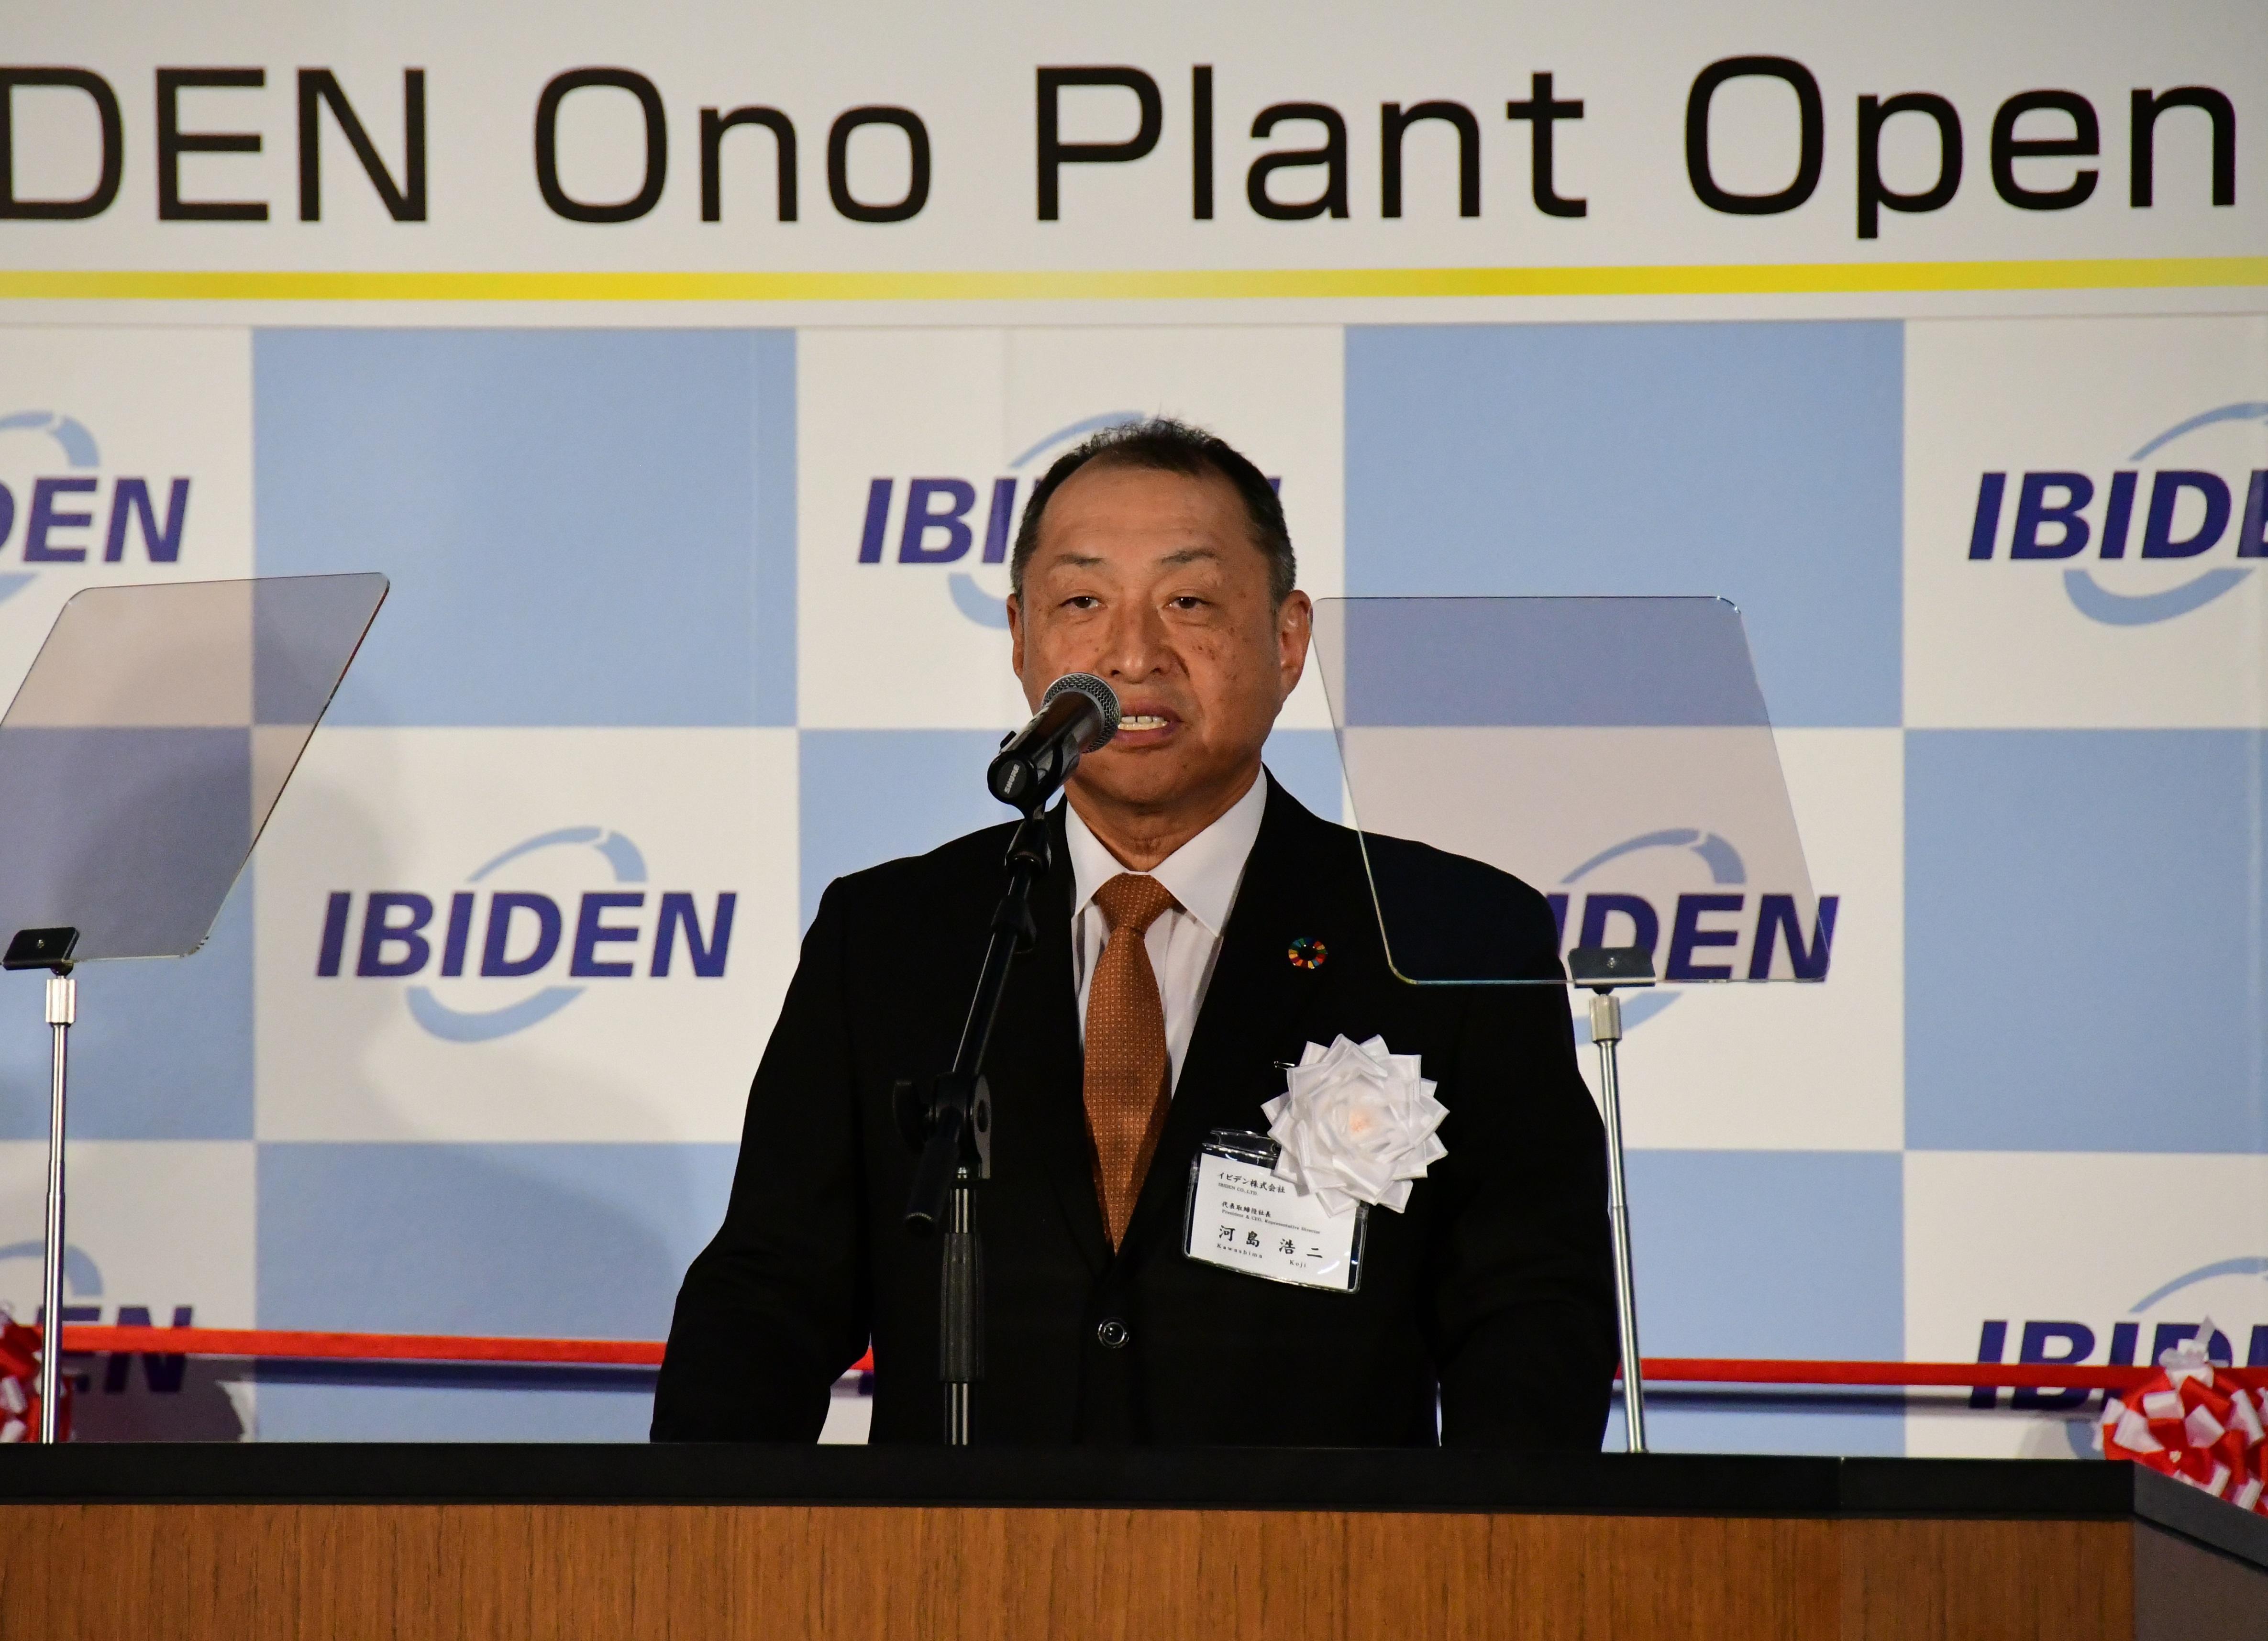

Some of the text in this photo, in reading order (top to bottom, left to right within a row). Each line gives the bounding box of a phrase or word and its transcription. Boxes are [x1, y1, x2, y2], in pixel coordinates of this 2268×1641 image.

[534, 66, 931, 224] Ono
[1036, 64, 1588, 221] Plant
[1684, 55, 2237, 240] Open
[0, 478, 189, 562] EN
[315, 891, 737, 979] IBIDEN
[1217, 1243, 1307, 1268] Kawashima Koji
[1222, 1209, 1244, 1217] President
[1264, 1219, 1299, 1230] Representative
